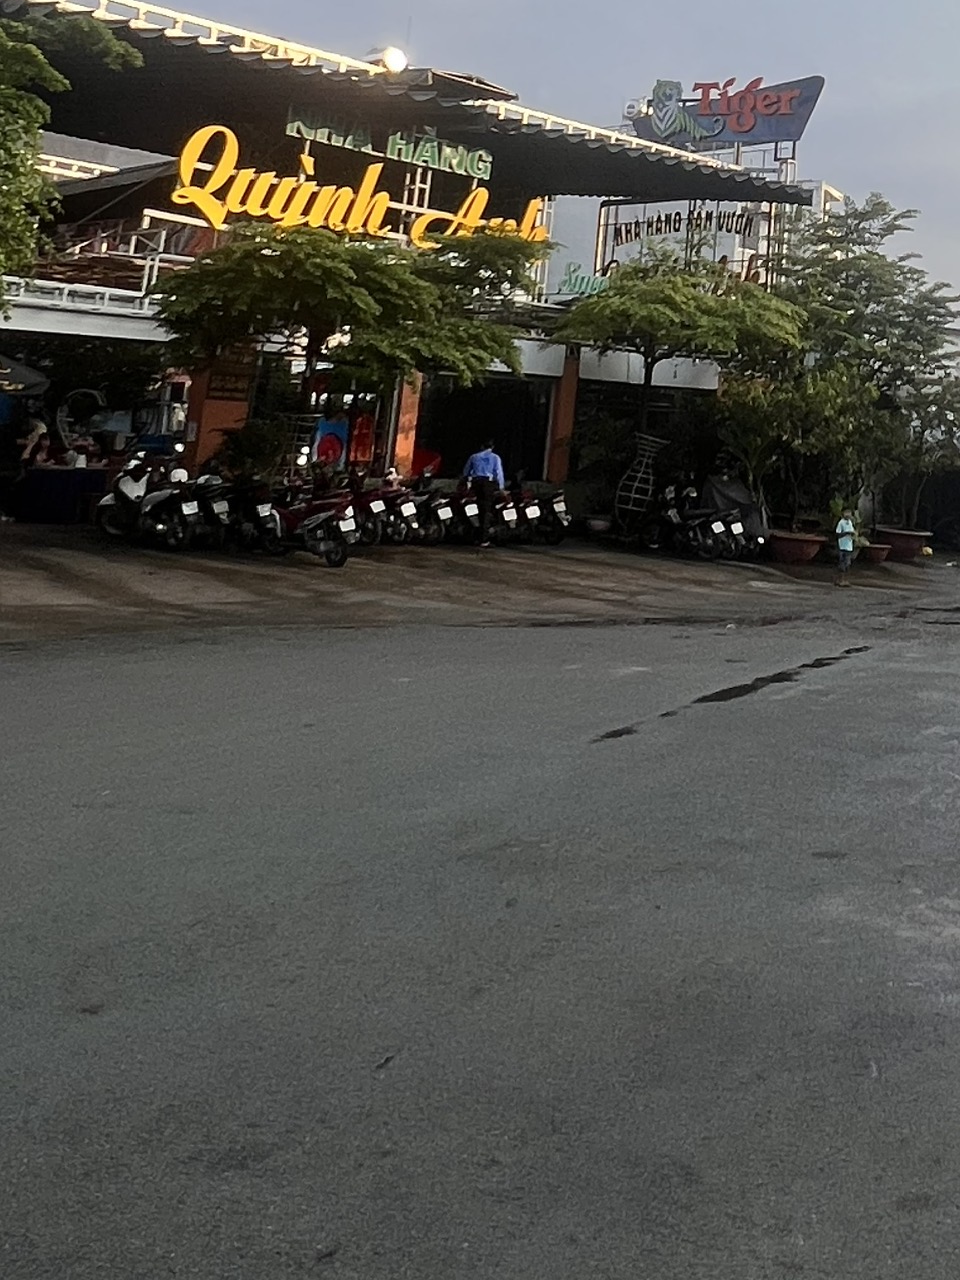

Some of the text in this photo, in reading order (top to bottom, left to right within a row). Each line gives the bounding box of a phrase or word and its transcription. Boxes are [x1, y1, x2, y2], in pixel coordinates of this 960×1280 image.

[692, 76, 804, 133] Tiger
[171, 124, 394, 237] Quỳnh
[386, 125, 494, 180] HÀNG
